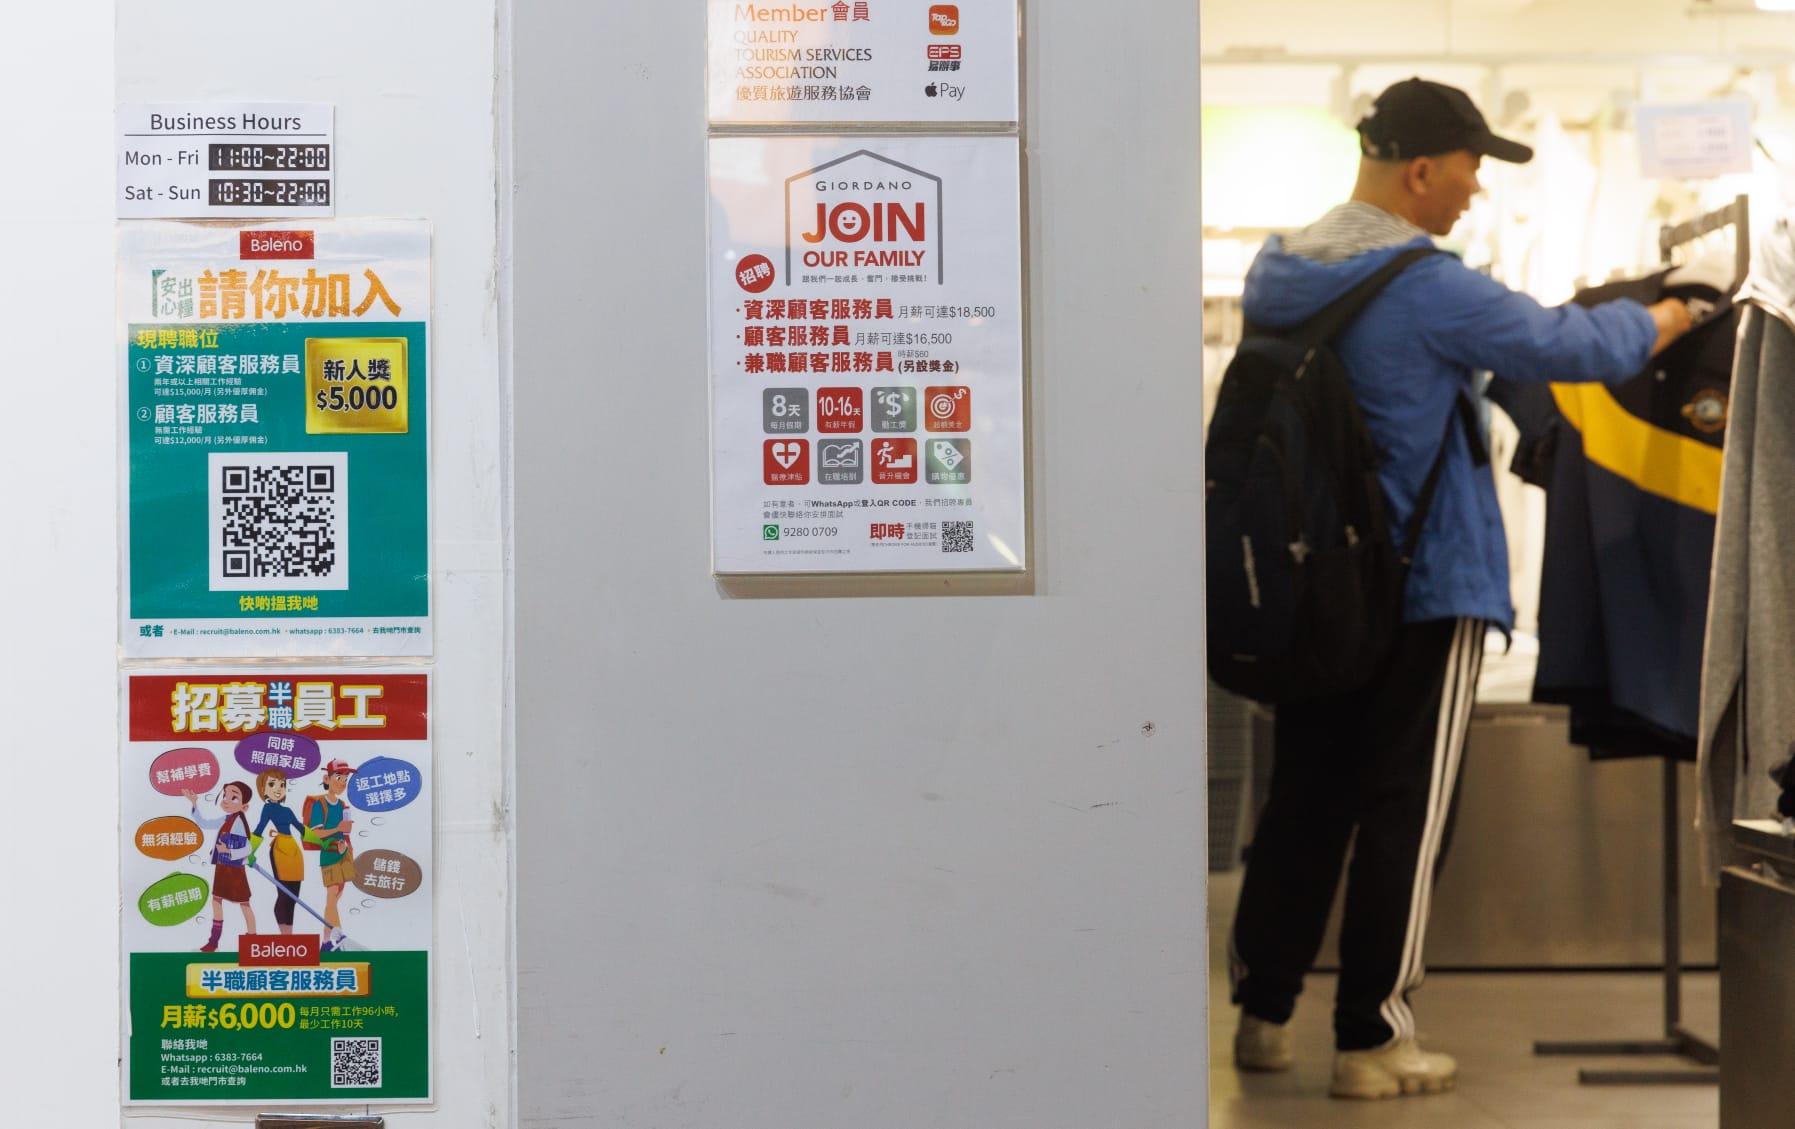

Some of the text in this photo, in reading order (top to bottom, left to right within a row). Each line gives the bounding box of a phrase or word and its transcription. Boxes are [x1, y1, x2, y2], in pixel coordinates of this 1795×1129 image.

[734, 1, 870, 22] Member 會員
[734, 30, 799, 44] QUALITY
[735, 48, 872, 61] TOURISM SERVICES
[929, 46, 960, 58] EPS
[735, 66, 837, 79] ASSOCIATION
[735, 85, 872, 101] 優質旅遊服務協會
[940, 82, 966, 101] Pay
[151, 113, 302, 131] Business Hours
[125, 150, 162, 166] Mon
[178, 150, 199, 166] Fri
[217, 147, 327, 168] 11:00~22:00
[125, 185, 152, 201] Sat
[168, 185, 201, 201] Sun
[217, 182, 327, 203] 10:30~22:00
[815, 180, 912, 192] GIORDANO
[801, 202, 926, 243] JOIN
[250, 238, 303, 252] Baleno
[803, 251, 926, 267] OUR FAMILY
[739, 262, 772, 286] 招聘
[197, 268, 402, 319] 請你加入
[744, 298, 995, 320] 資深顧客服務員 月薪可達$18,500
[136, 328, 219, 349] 現聘職位
[744, 325, 952, 347] 顧客服務員 月薪可達$16,500
[154, 355, 301, 375] 資深顧客服務員
[323, 359, 391, 381] 新人獎
[745, 351, 894, 373] 兼職顧客服務員
[898, 360, 960, 374] (另設獎金)
[317, 385, 398, 412] $5,000
[819, 396, 861, 416] 10-16天
[154, 404, 260, 424] 顧客服務員
[783, 527, 838, 536] 9280 0709
[870, 522, 905, 540] 即時
[139, 624, 164, 638] 或者
[199, 626, 281, 636] recruit@baleno.com.hk
[267, 736, 295, 751] 同時
[250, 750, 307, 770] 照顧家庭
[356, 769, 412, 791] 返工地點
[366, 788, 407, 806] 選擇多
[142, 831, 198, 848] 無須經驗
[363, 874, 406, 892] 去旅行
[147, 887, 203, 912] 有薪假期
[251, 944, 308, 958] Baleno
[201, 969, 357, 992] 半職顧客服務員
[299, 1018, 364, 1030] 最少工作10天
[161, 1053, 207, 1064] Whatsapp
[214, 1053, 263, 1062] 6383-7664
[161, 1065, 190, 1074] E-Mail
[197, 1064, 308, 1075] recruit@baleno.com.hk
